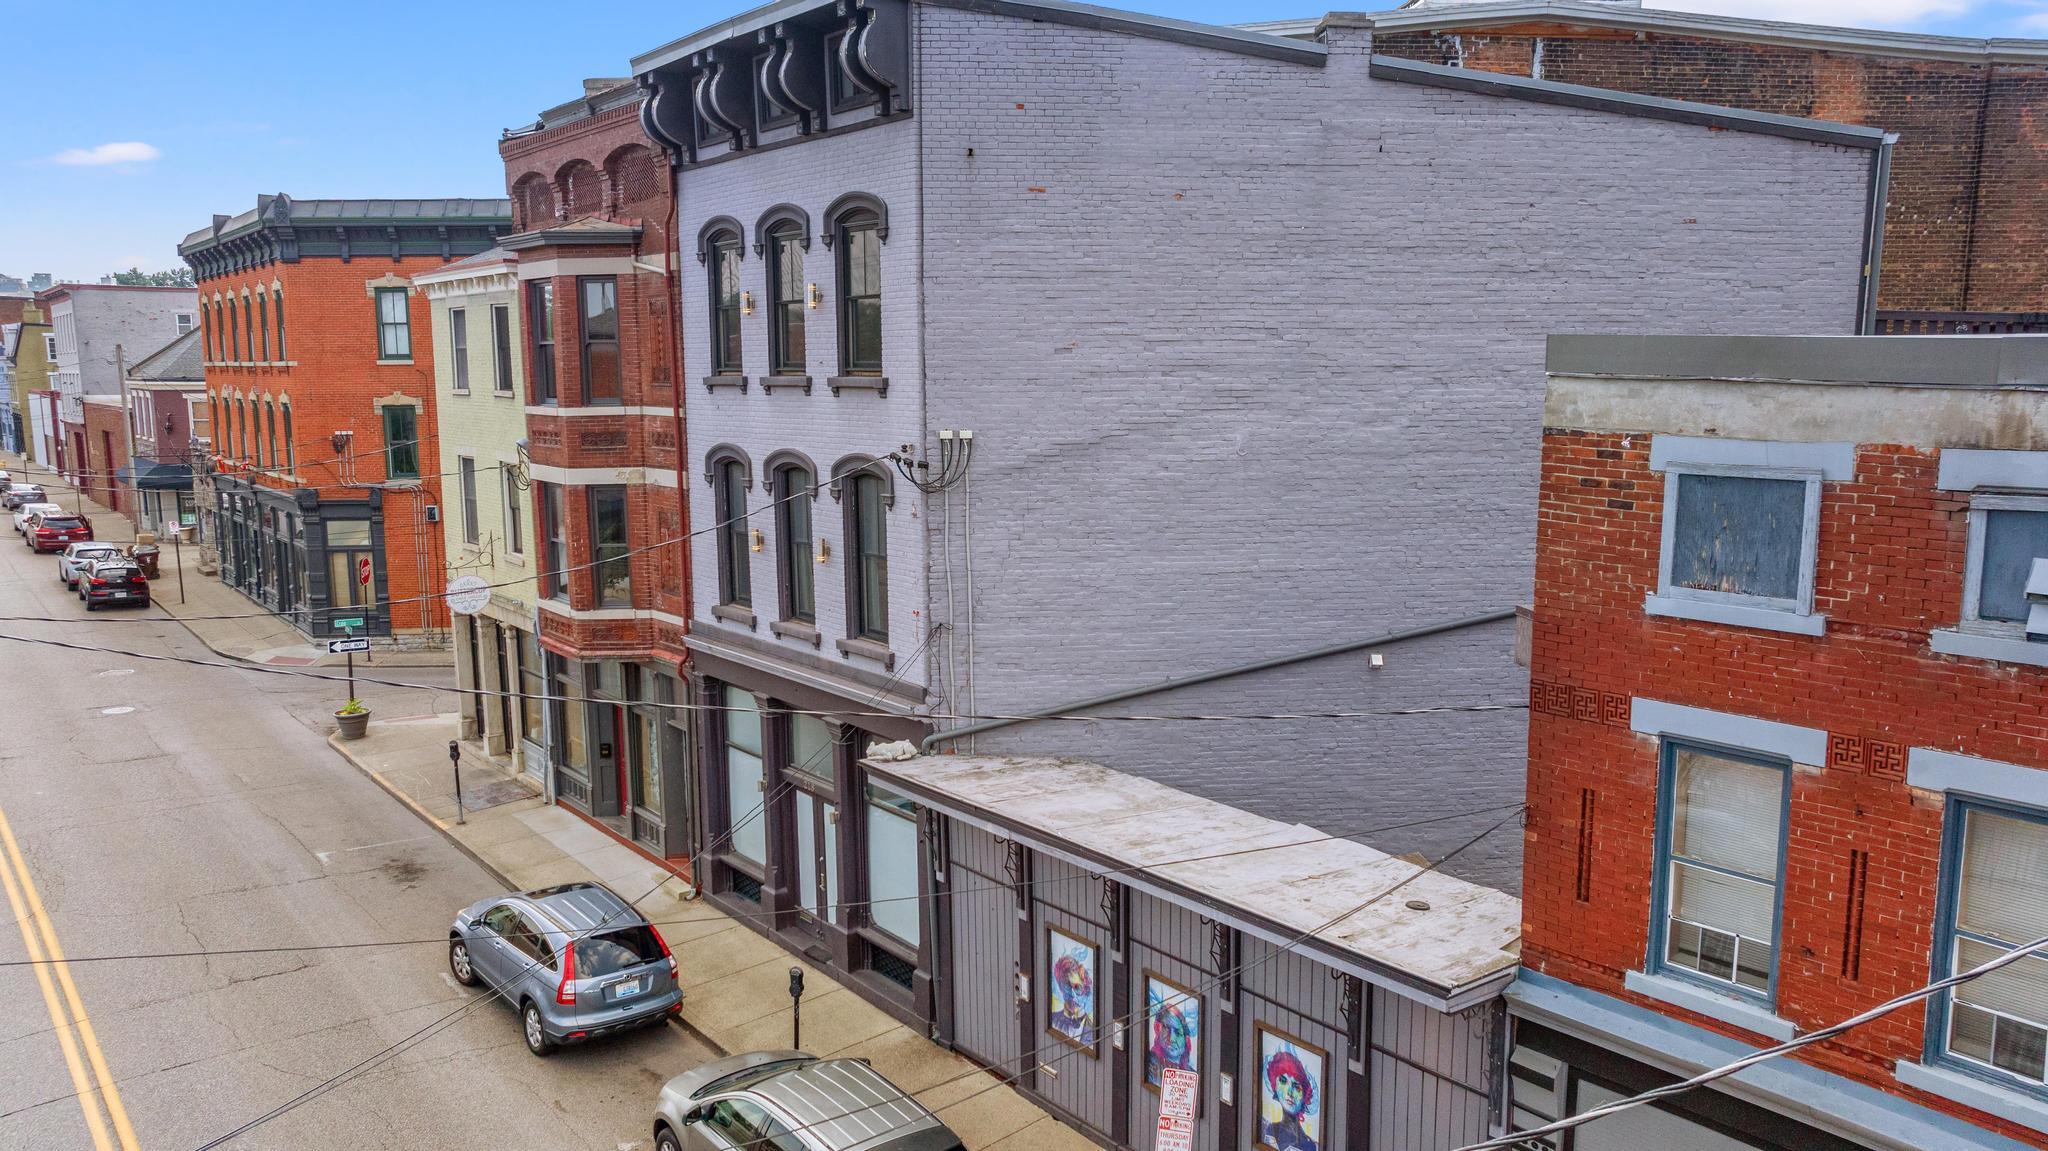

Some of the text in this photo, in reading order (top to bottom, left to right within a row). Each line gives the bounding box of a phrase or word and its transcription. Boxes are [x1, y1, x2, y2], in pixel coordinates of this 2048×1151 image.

[1165, 1070, 1175, 1079] NO
[1165, 1079, 1194, 1089] LOADING
[1170, 1086, 1187, 1095] ZONE
[1159, 1119, 1170, 1129] NO
[1160, 1132, 1189, 1141] THURSDAY
